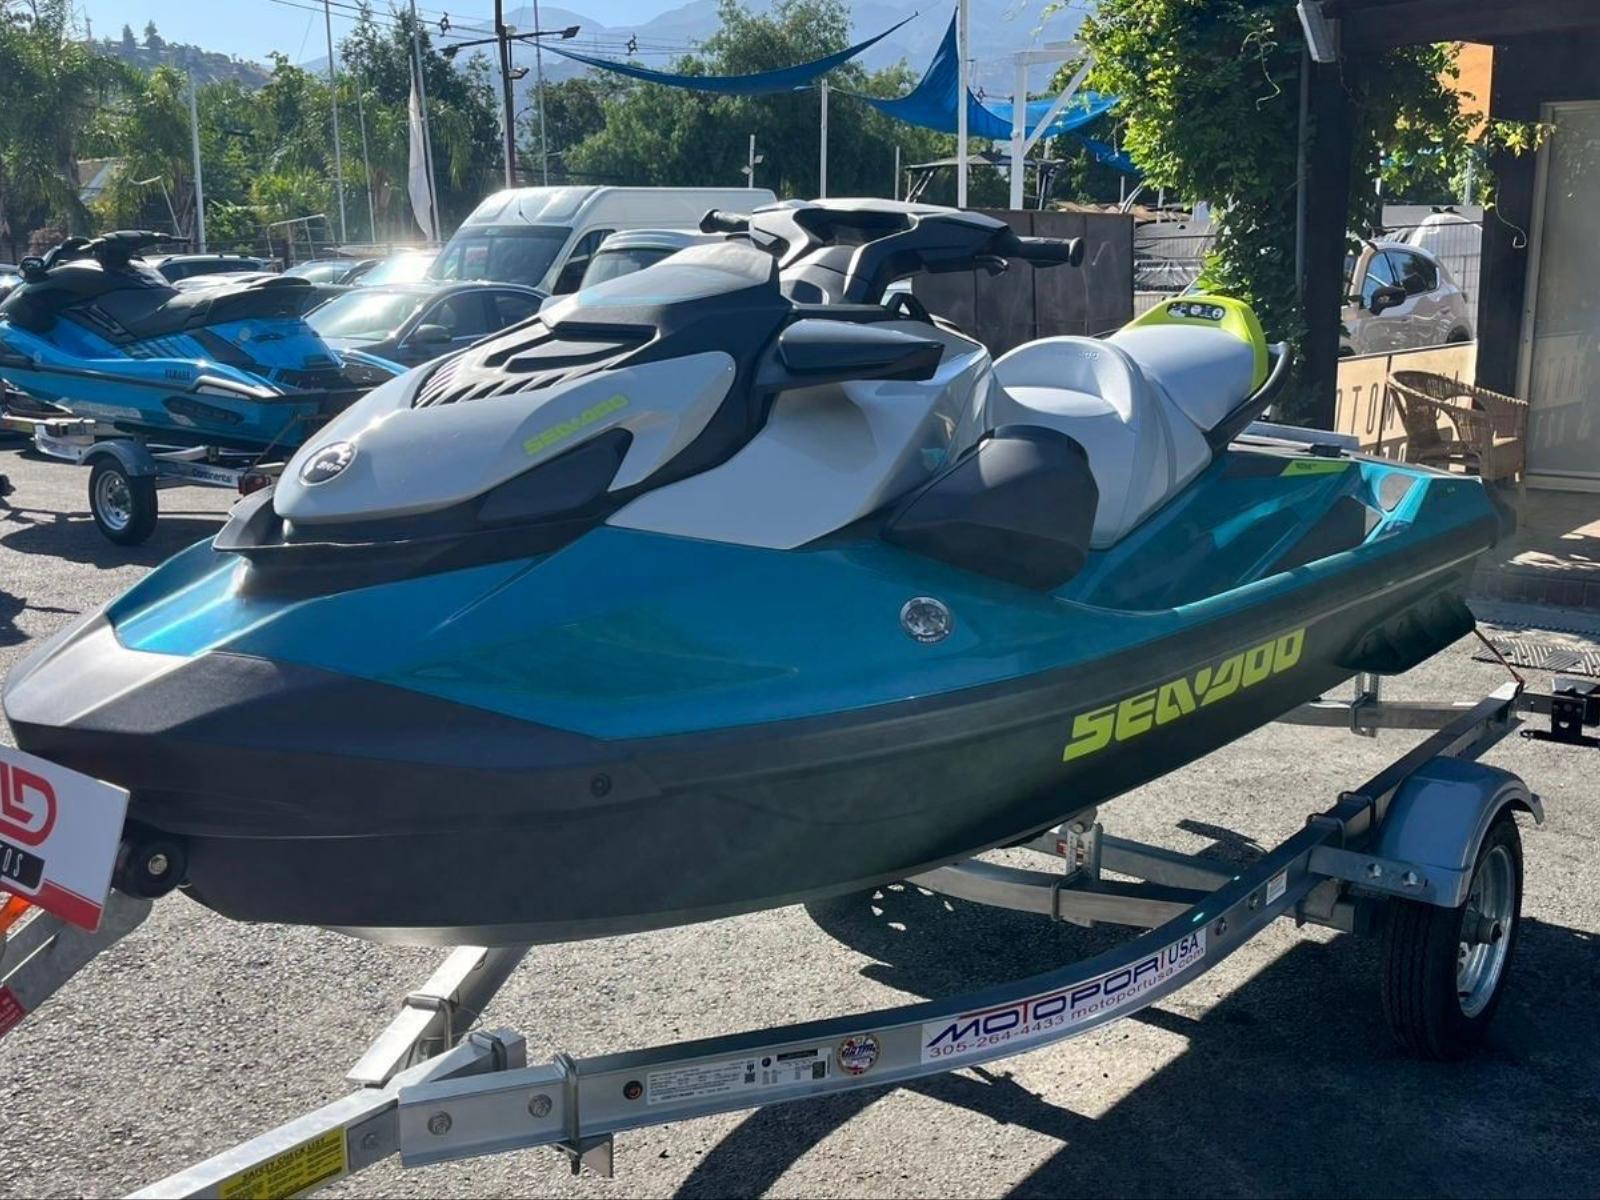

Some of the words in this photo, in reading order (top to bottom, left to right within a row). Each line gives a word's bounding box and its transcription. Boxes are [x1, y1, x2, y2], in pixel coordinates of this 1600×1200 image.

[0, 843, 23, 878] OS
[929, 1014, 1065, 1059] 305-264-4433
[1071, 946, 1205, 1021] motoportusa.com
